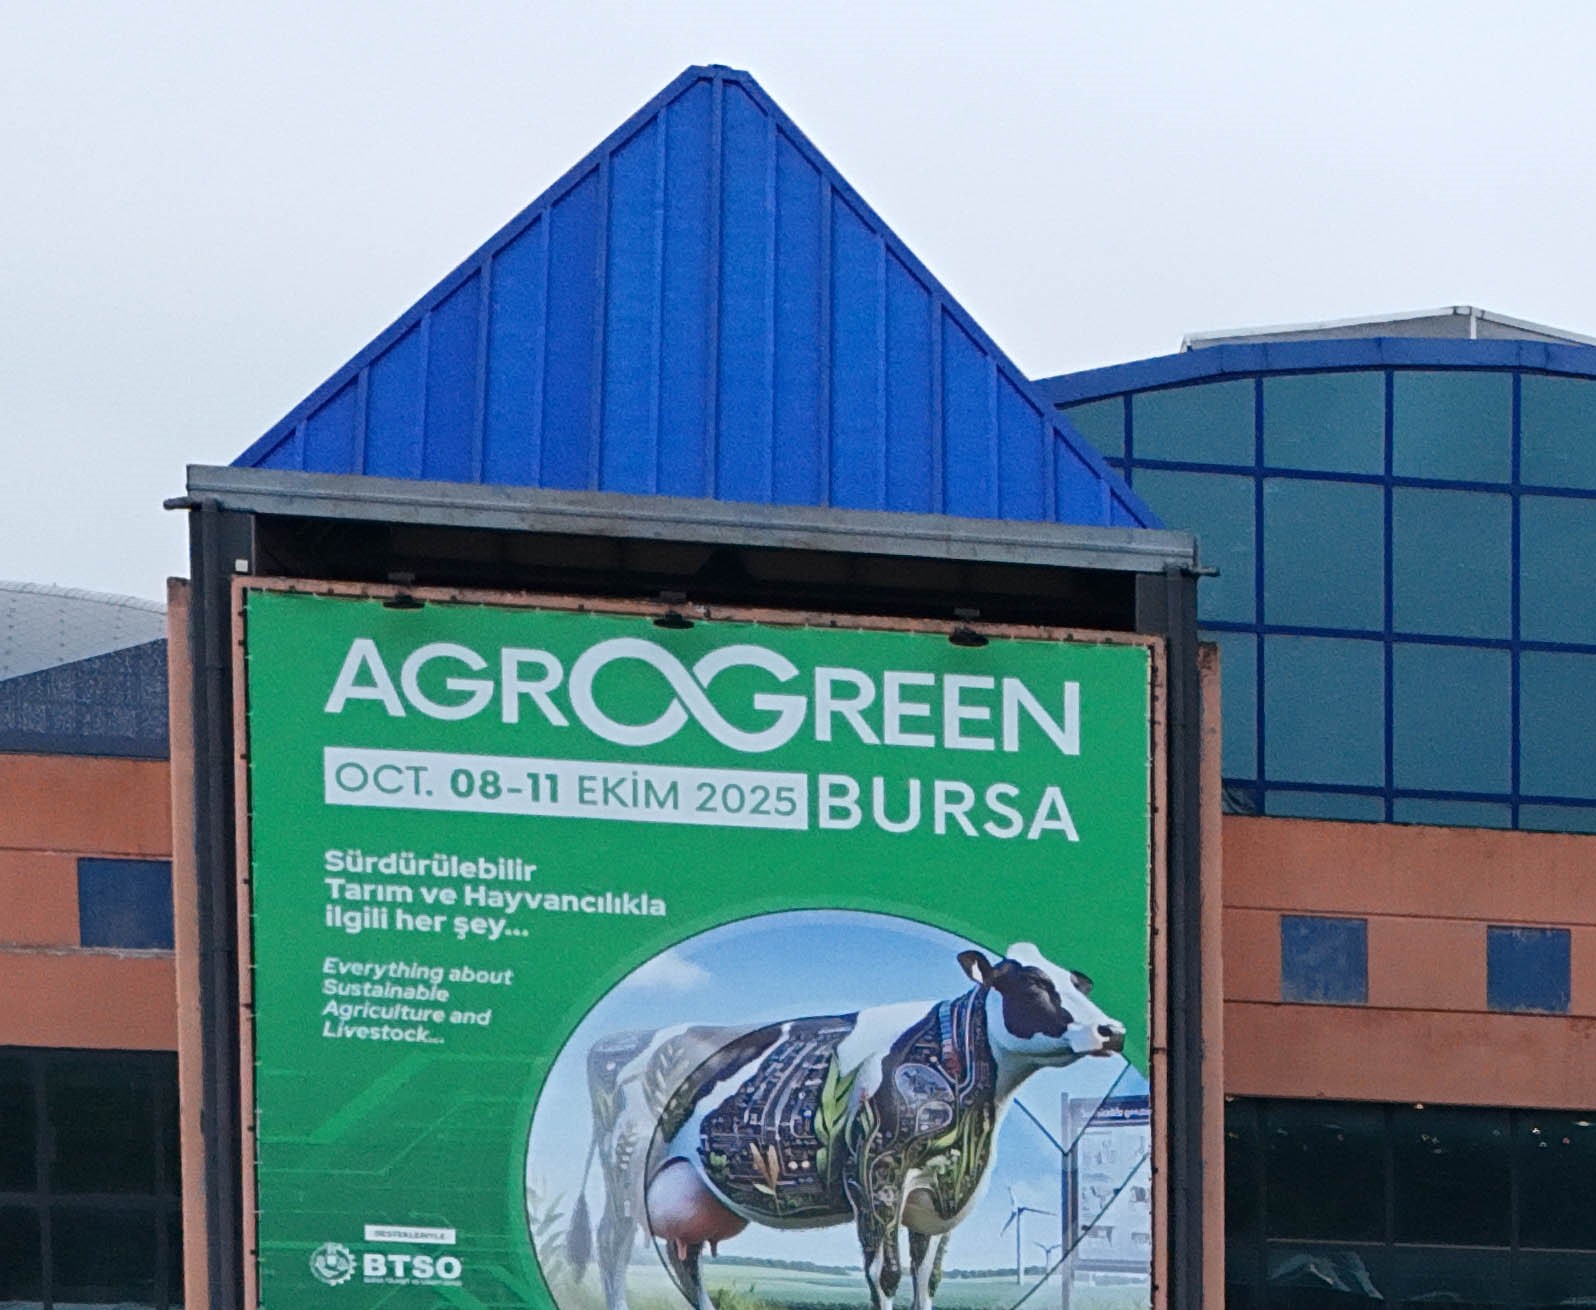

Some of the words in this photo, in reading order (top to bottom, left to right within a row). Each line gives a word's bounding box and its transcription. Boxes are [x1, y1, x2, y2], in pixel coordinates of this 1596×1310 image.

[324, 636, 1081, 756] AGROGREEN
[335, 761, 434, 798] OCT.
[449, 768, 559, 805] 08-11
[577, 768, 680, 811] EKİM
[696, 779, 797, 816] 2025
[818, 773, 1080, 842] BURSA
[324, 848, 537, 882] Sürdürülebilir
[324, 877, 412, 904] Tarım
[420, 888, 456, 906] ve
[464, 882, 666, 919] Hayvancılıkla
[324, 903, 388, 933] ilgili
[396, 907, 446, 932] her
[452, 914, 529, 941] şey...
[323, 957, 442, 986] Everything
[449, 966, 513, 986] about
[323, 978, 450, 1003] Sustainable
[323, 1000, 445, 1025] Agriculture
[451, 1006, 491, 1025] and
[363, 1253, 461, 1278] BTSO
